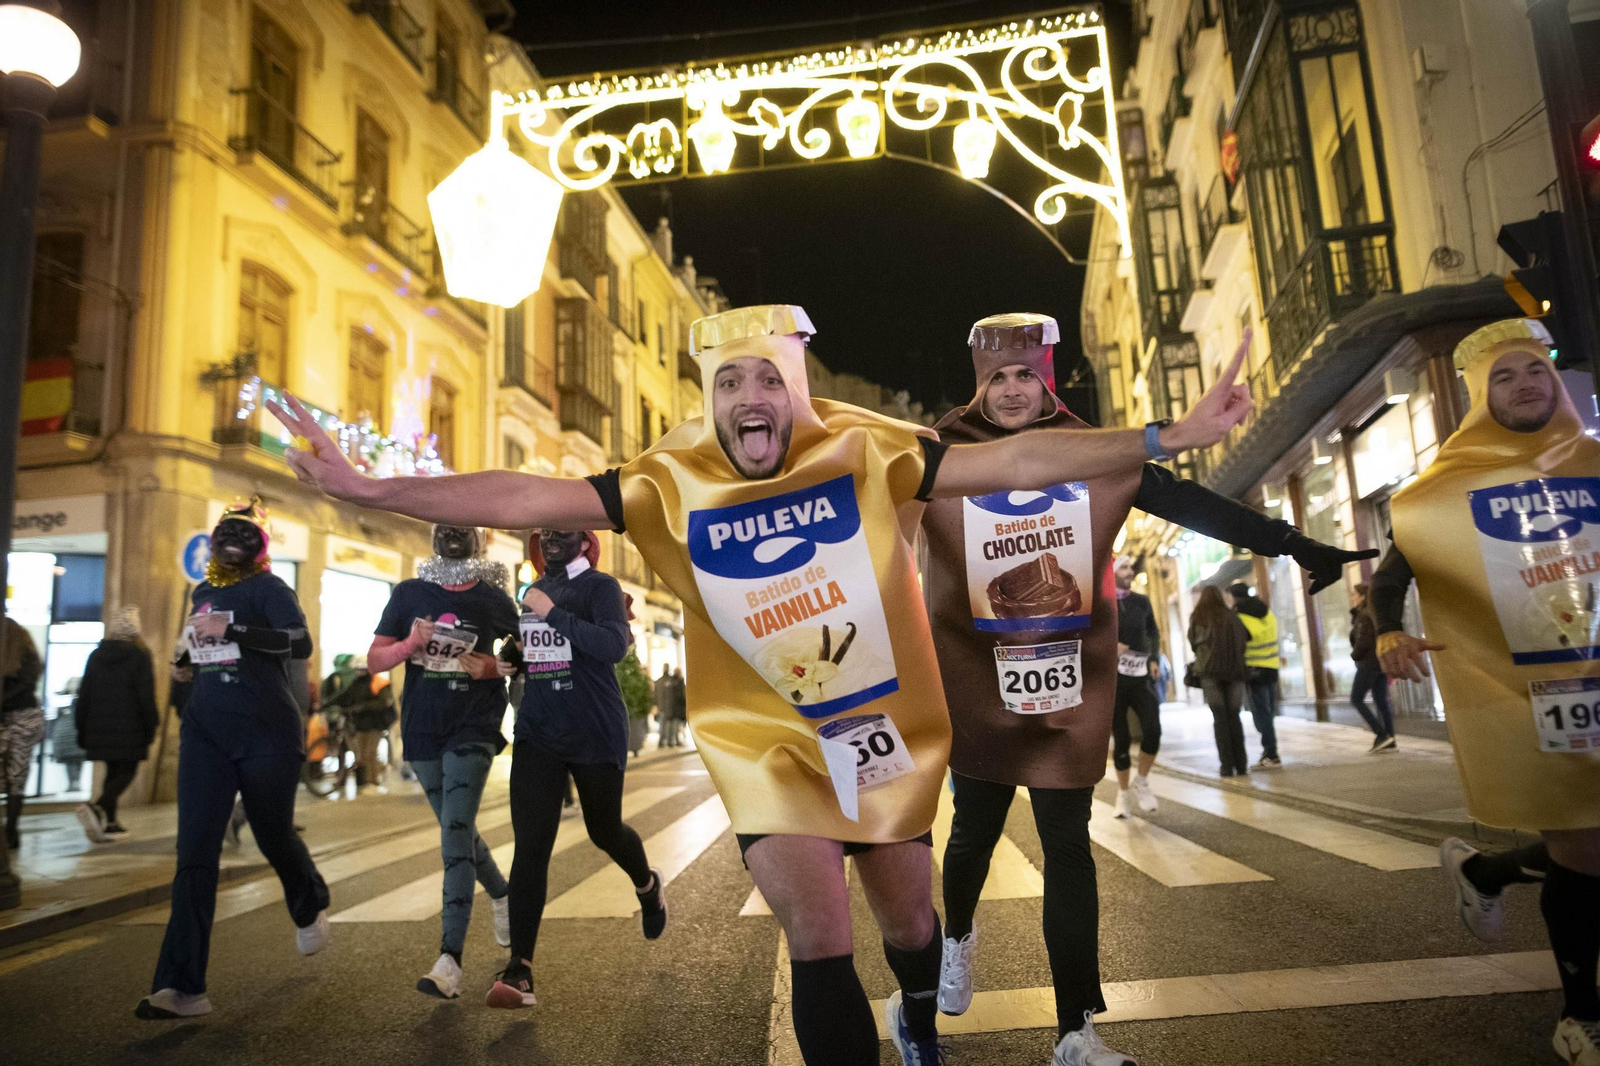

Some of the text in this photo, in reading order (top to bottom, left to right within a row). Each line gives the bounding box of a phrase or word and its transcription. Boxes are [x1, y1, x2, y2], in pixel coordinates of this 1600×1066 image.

[1489, 490, 1598, 519] PULEVA
[13, 511, 67, 532] ange
[707, 496, 837, 551] PULEVA
[994, 514, 1056, 537] Batido de
[982, 526, 1075, 561] CHOCOLATE
[745, 565, 827, 609] Batido de
[744, 580, 847, 639] VAINILLA
[426, 640, 467, 658] 642
[523, 629, 565, 647] 1608
[998, 648, 1008, 660] 32
[1004, 664, 1077, 694] 2063
[848, 731, 895, 767] 60
